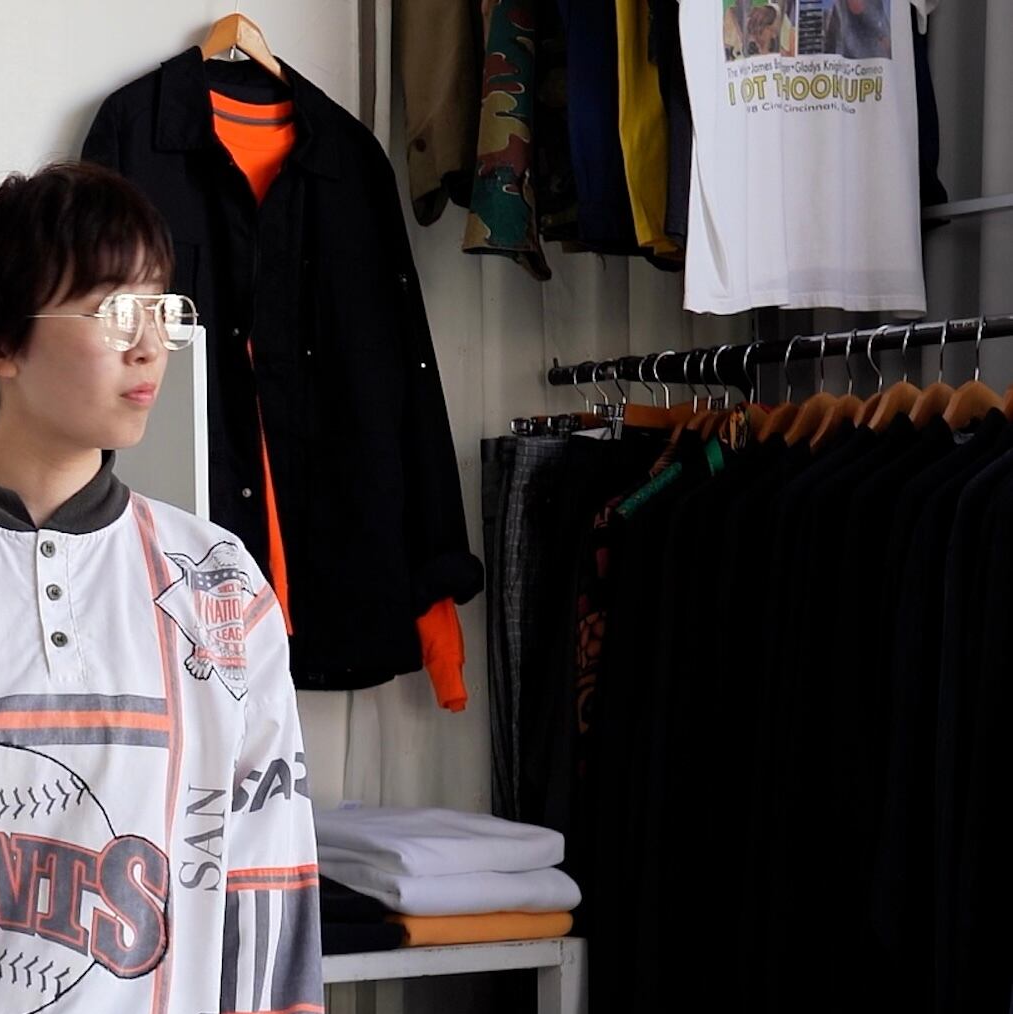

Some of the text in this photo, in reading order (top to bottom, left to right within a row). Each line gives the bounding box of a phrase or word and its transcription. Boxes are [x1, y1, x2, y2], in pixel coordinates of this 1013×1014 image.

[795, 60, 821, 75] Gladys
[855, 63, 884, 76] Cameo
[205, 597, 241, 625] NATIO
[178, 784, 227, 892] SAN
